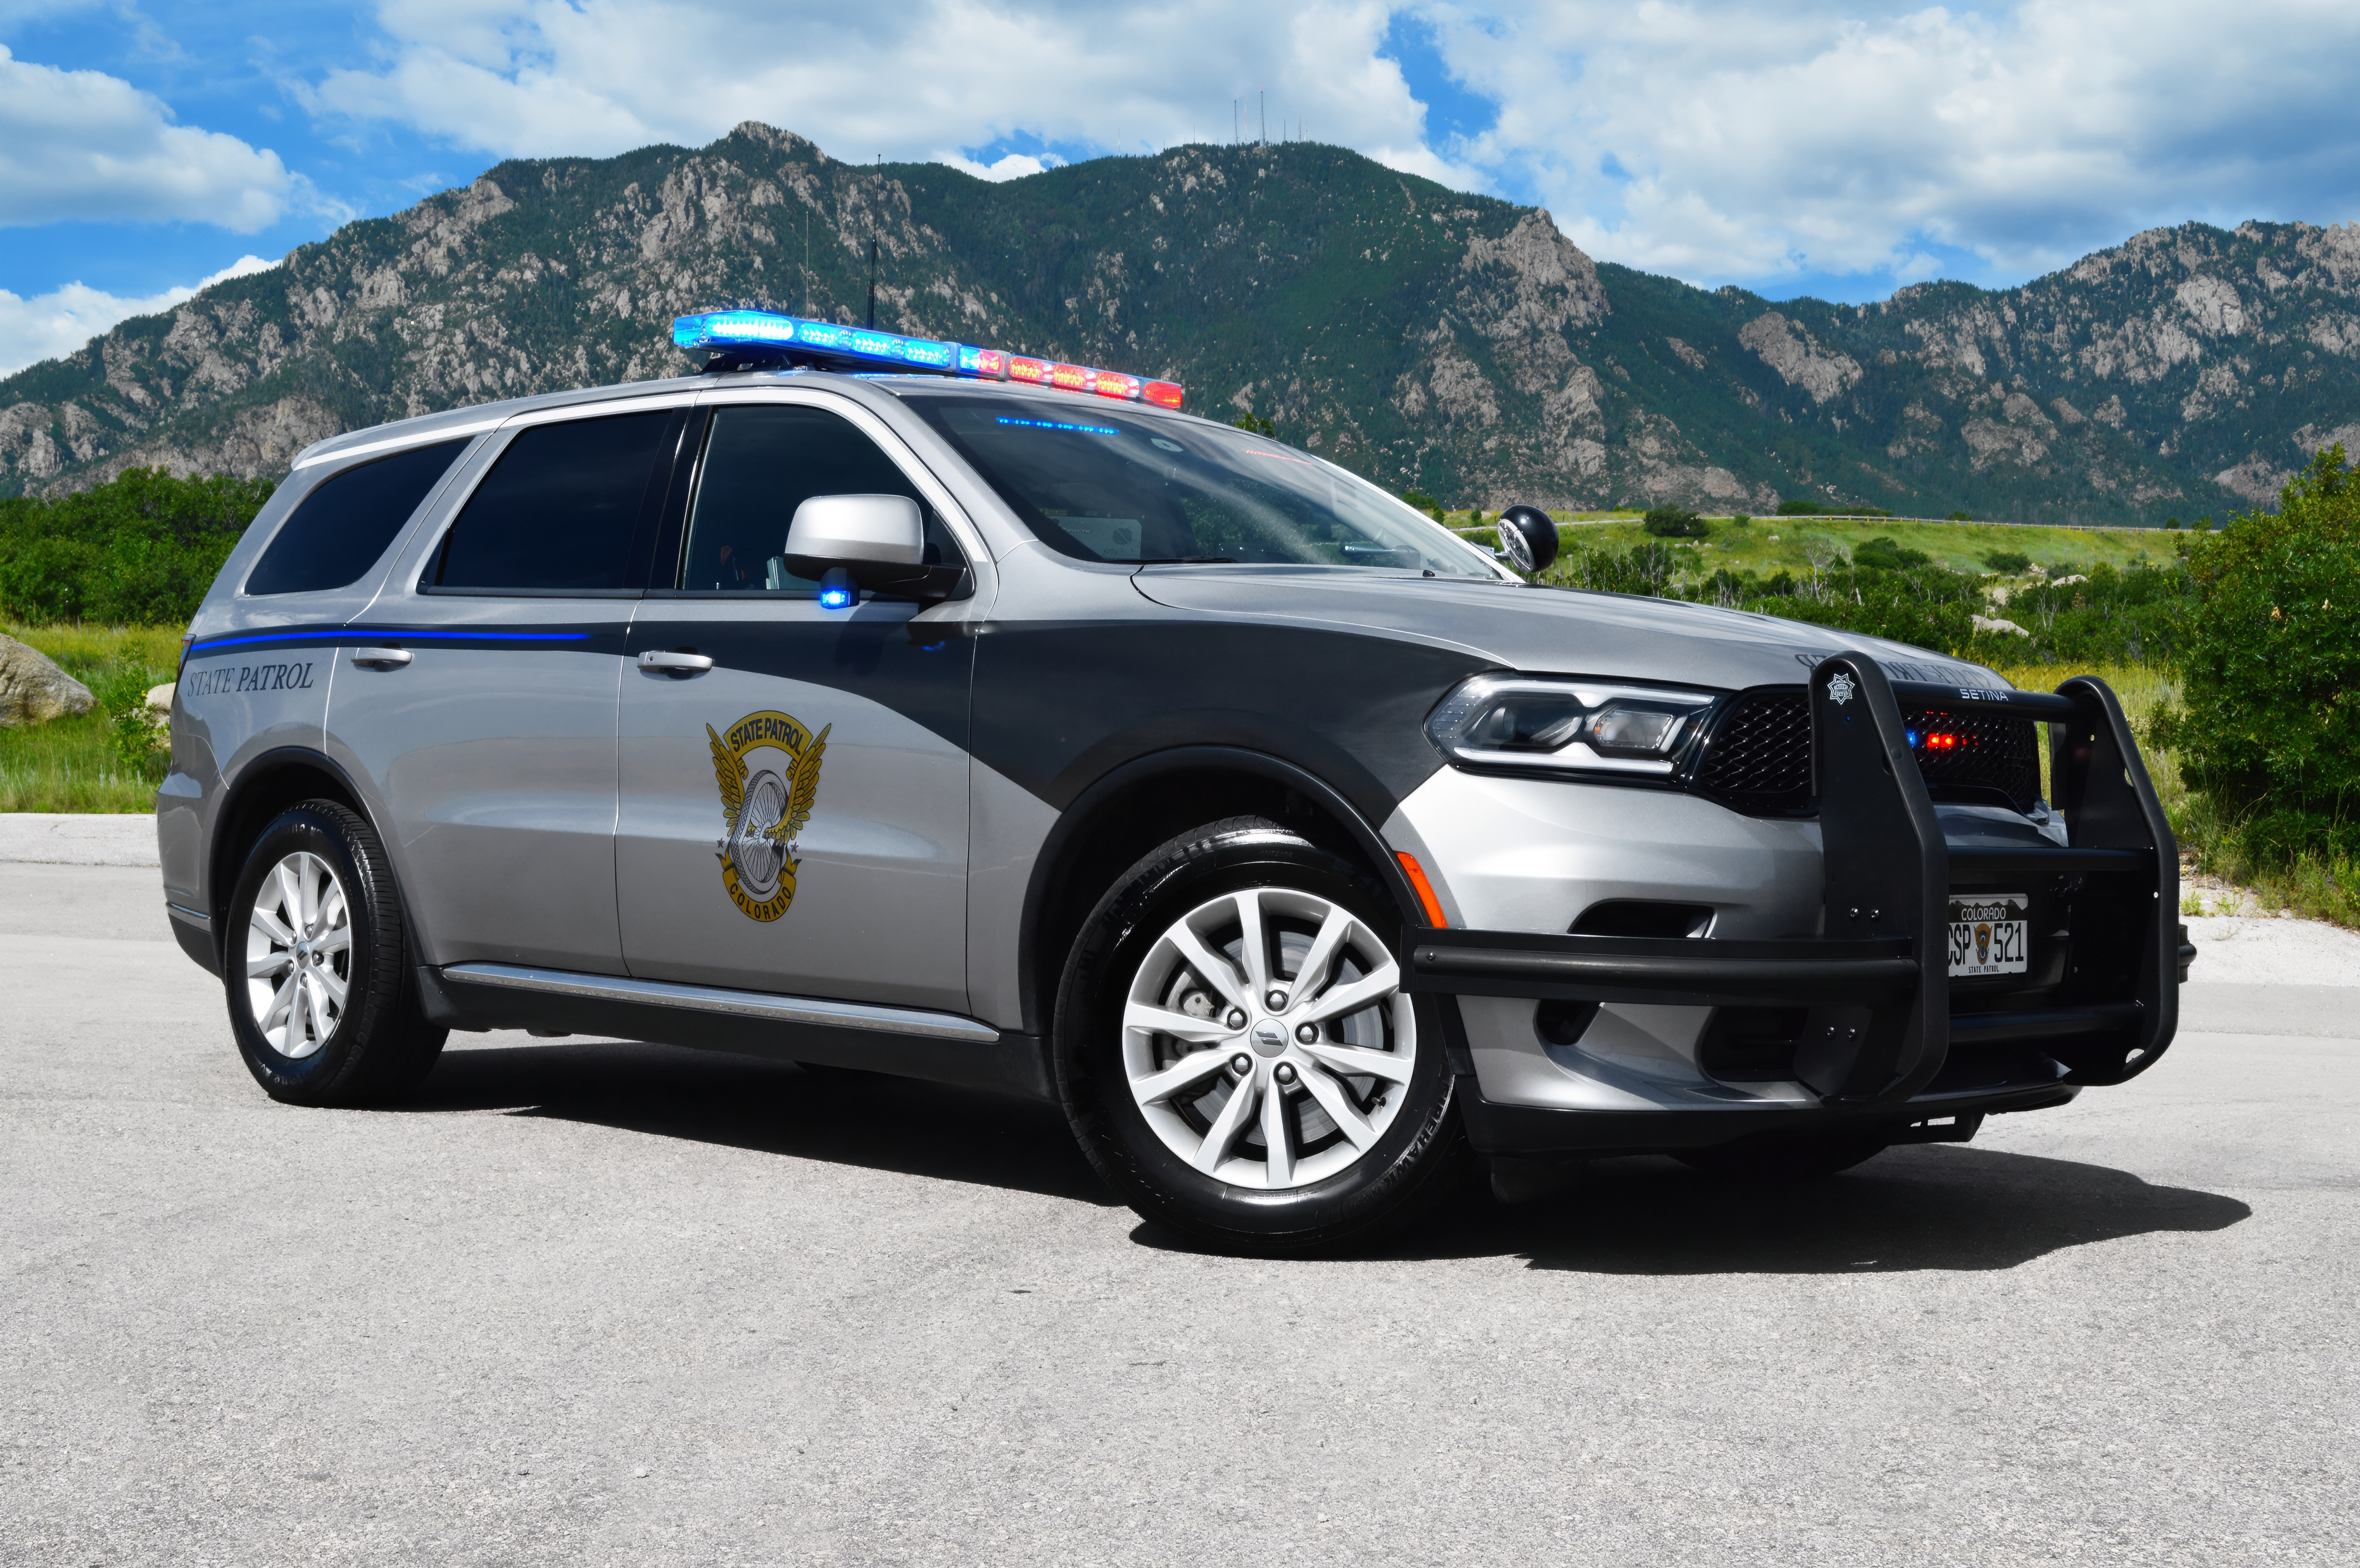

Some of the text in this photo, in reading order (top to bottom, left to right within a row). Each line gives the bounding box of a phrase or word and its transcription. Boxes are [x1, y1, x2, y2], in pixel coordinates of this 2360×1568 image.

[187, 663, 314, 697] STATE PATROL
[1960, 689, 2009, 702] SETINA
[730, 717, 803, 756] STATE PATROL
[730, 882, 792, 920] COLORADO
[1961, 907, 2007, 921] COLORADO
[1994, 922, 2024, 963] 521
[1983, 965, 2000, 974] PATROL
